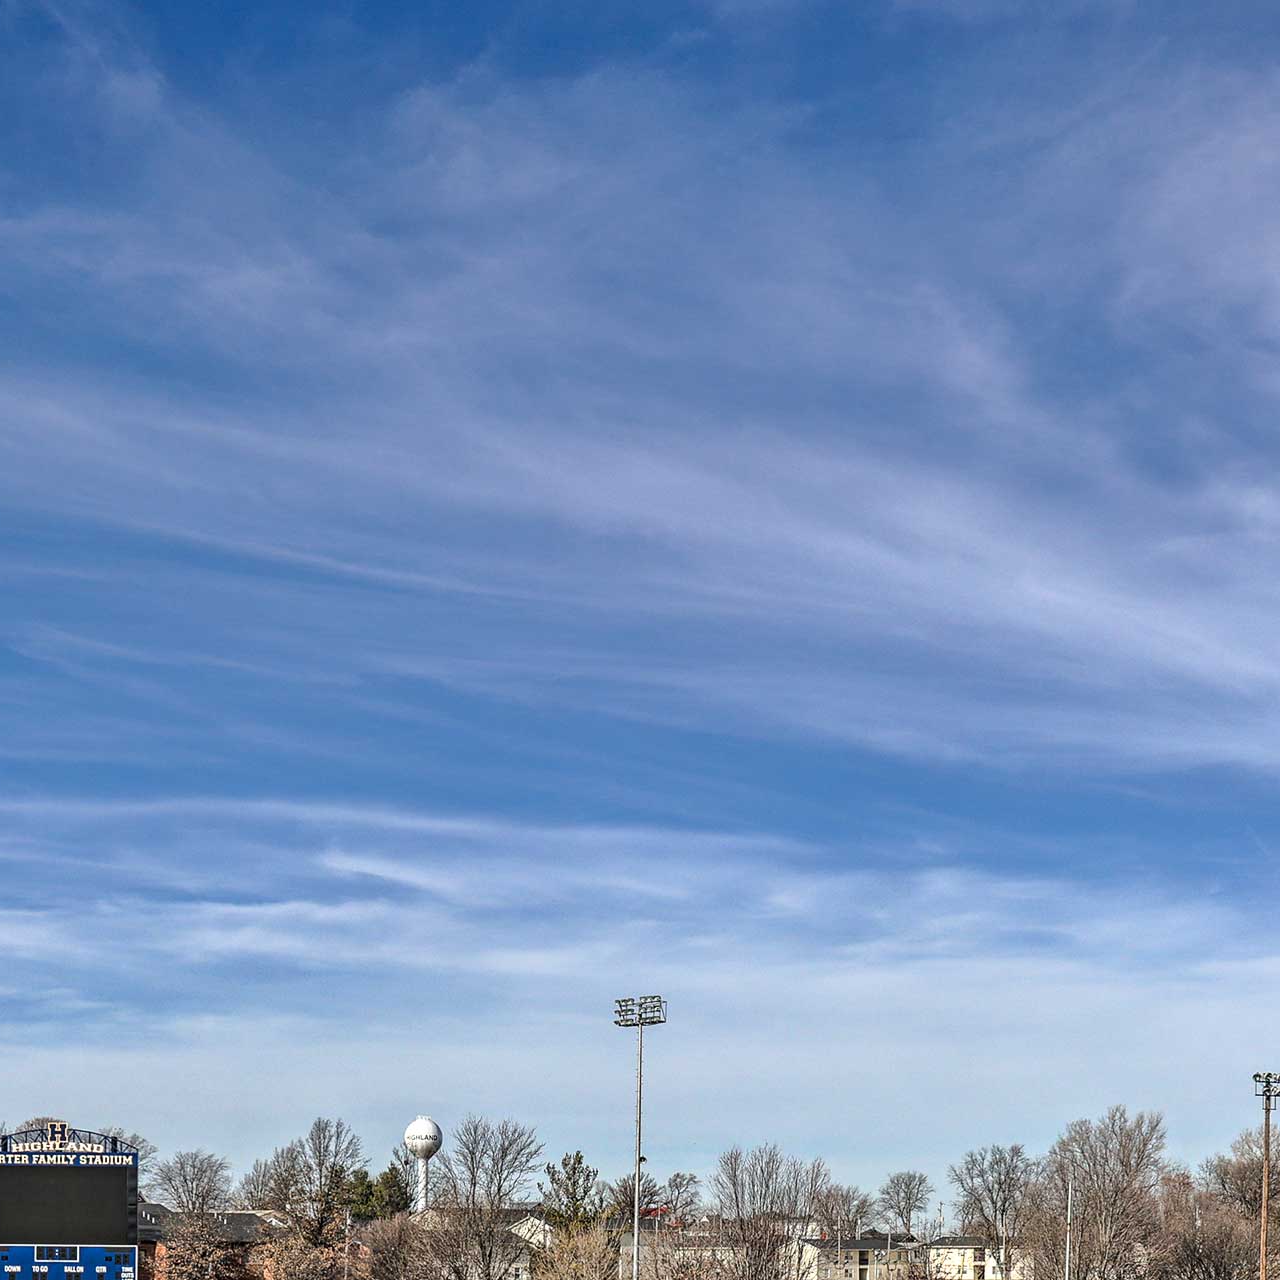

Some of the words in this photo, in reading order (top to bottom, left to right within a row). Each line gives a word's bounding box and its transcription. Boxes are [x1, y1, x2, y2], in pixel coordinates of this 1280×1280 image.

[47, 1122, 68, 1143] H
[12, 1141, 104, 1153] HIGHLAND
[32, 1153, 77, 1165] FAMILY
[79, 1153, 133, 1165] STADIUM
